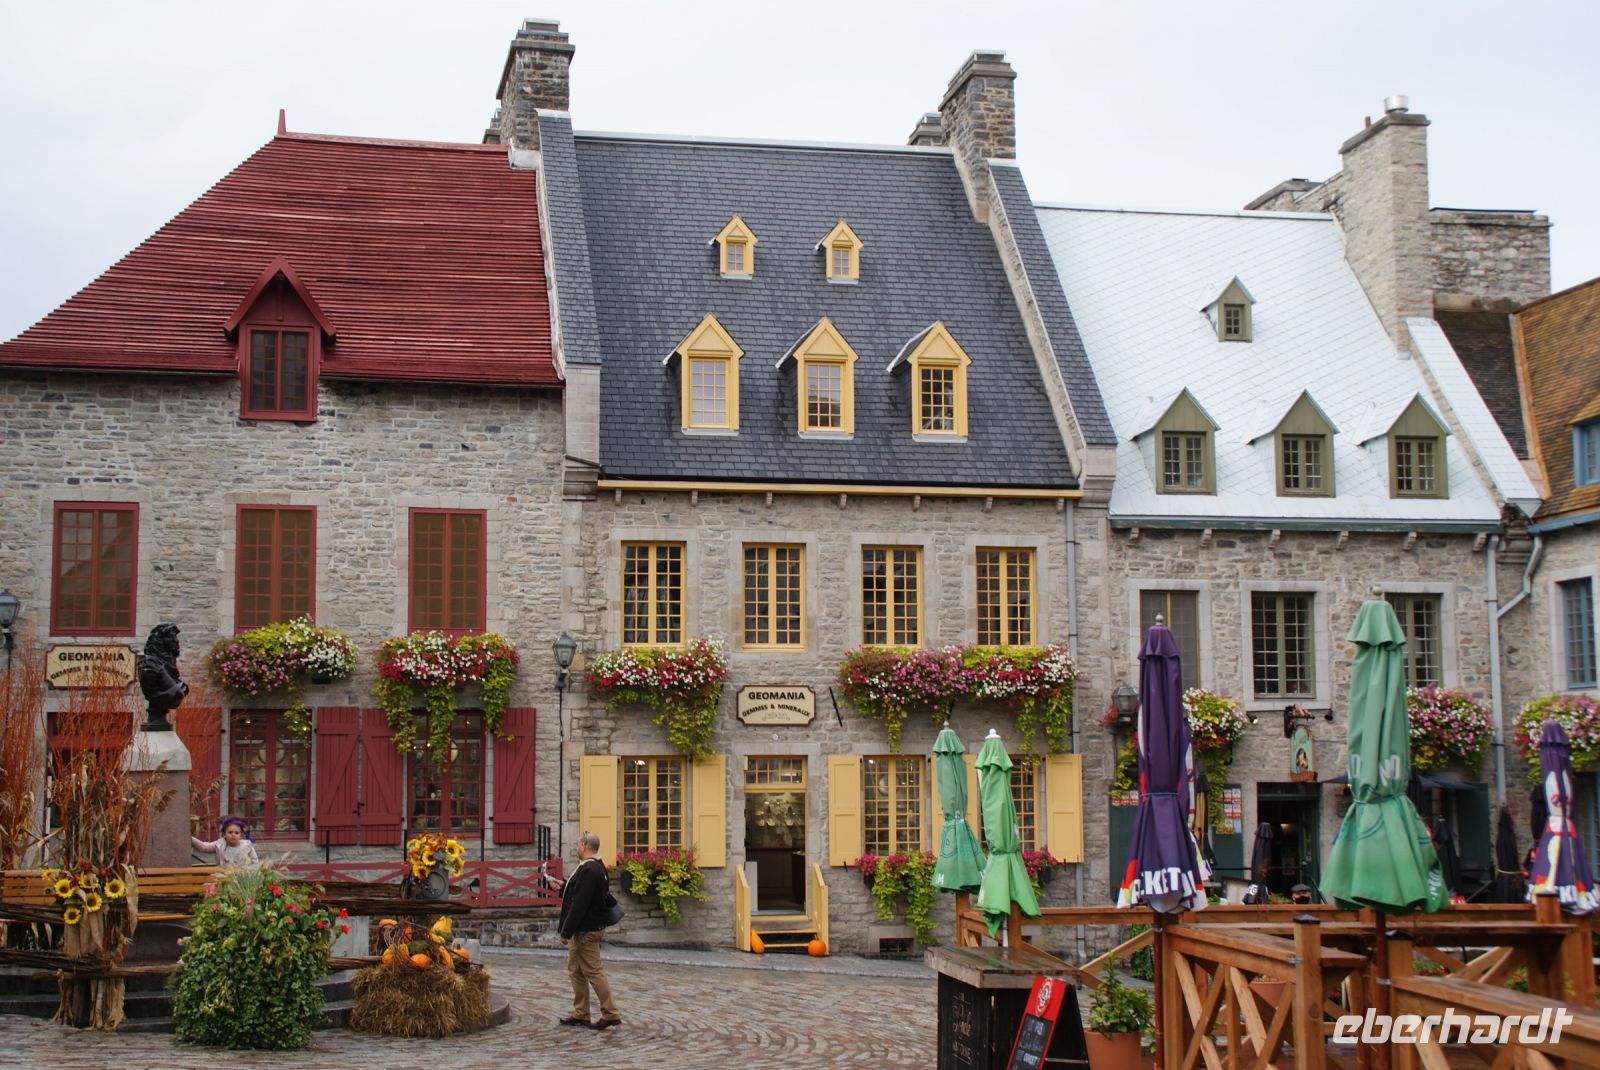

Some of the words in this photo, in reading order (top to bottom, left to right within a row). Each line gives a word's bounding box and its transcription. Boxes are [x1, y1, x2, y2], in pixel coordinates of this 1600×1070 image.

[58, 652, 125, 662] GEOMANIA
[748, 691, 806, 700] GEOMANIA
[742, 704, 769, 717] GEMMES
[777, 704, 811, 718] MINERAUX
